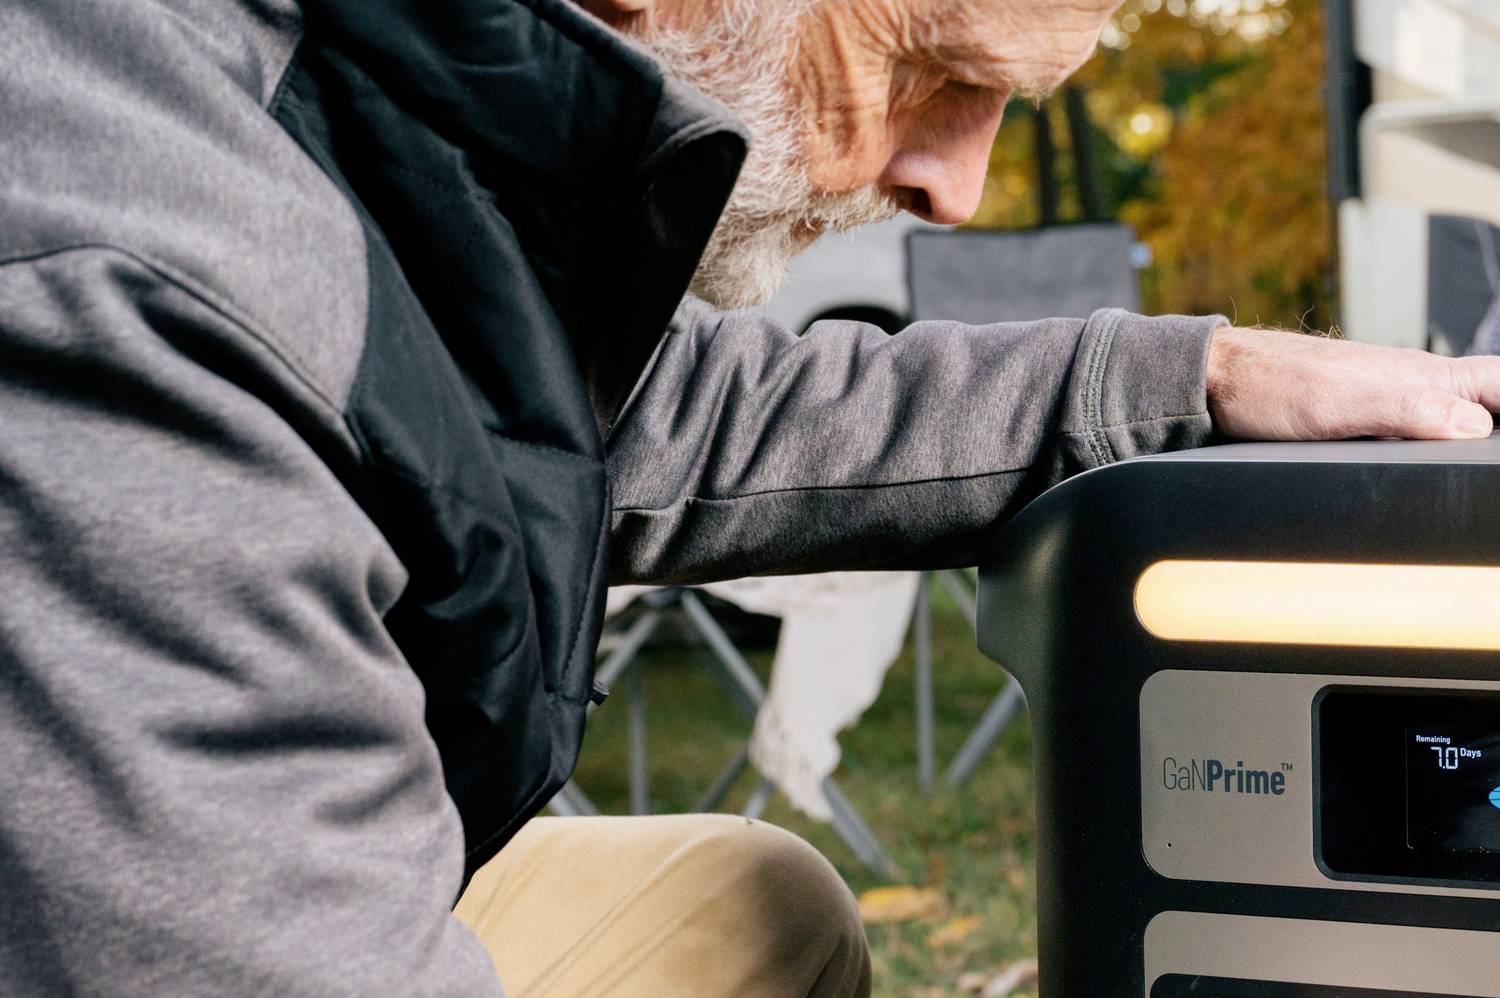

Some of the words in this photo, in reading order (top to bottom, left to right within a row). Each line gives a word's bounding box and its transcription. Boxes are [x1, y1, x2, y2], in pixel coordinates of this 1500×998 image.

[1415, 734, 1451, 745] Remaining
[1430, 746, 1458, 770] 7.0
[1460, 747, 1482, 760] Days
